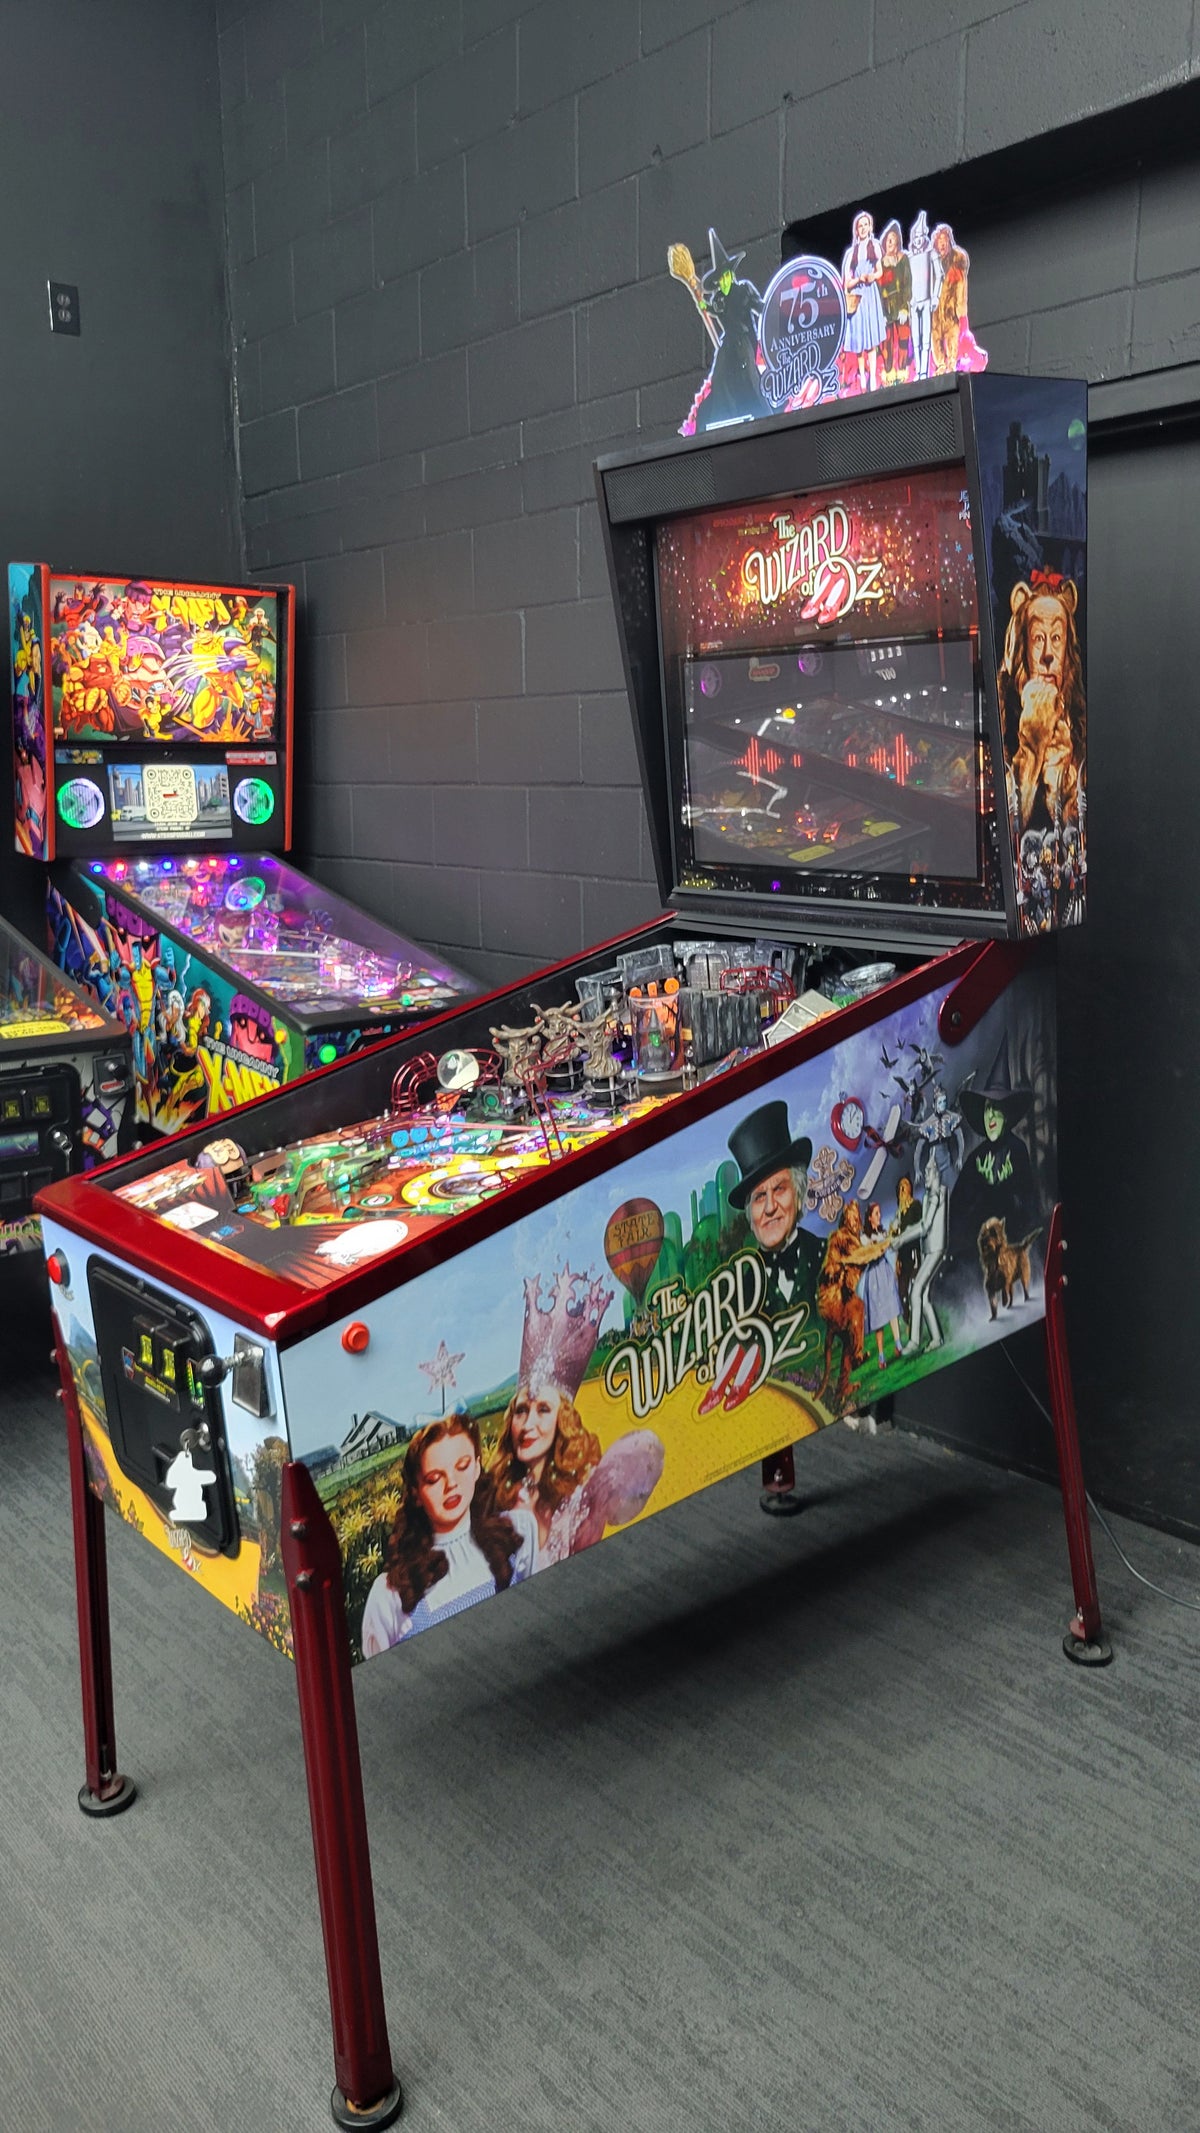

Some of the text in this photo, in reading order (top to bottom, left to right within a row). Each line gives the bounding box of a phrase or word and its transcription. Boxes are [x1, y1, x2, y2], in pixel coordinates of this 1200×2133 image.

[780, 281, 829, 334] 75th
[770, 323, 836, 352] ANNIVERSARY
[764, 343, 818, 401] WIZARD
[773, 514, 796, 540] The
[745, 506, 849, 605] WIZARD
[801, 569, 816, 596] of
[203, 1035, 280, 1078] THE UNCANNY
[613, 1213, 654, 1238] STATE
[618, 1227, 649, 1248] FAIR
[652, 1283, 688, 1320] The
[605, 1254, 763, 1417] WIZARD
[697, 1345, 718, 1384] of
